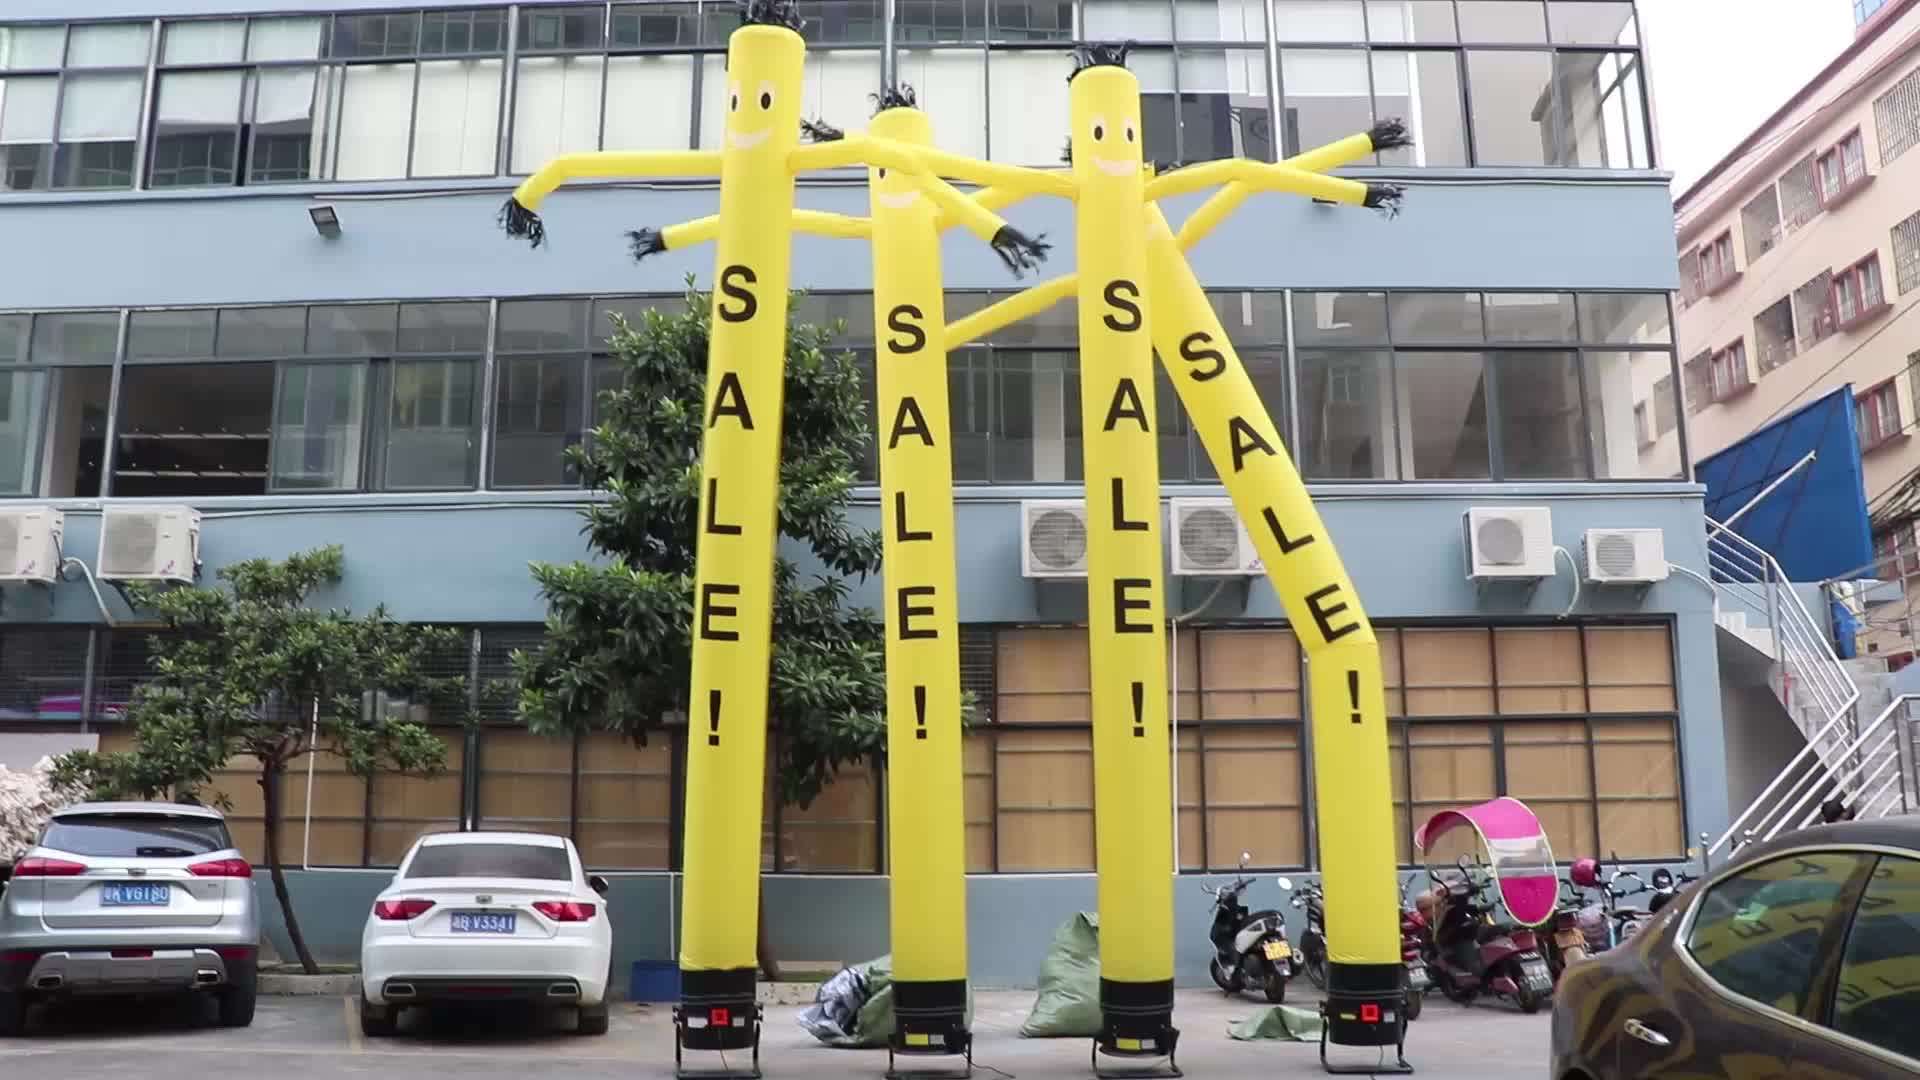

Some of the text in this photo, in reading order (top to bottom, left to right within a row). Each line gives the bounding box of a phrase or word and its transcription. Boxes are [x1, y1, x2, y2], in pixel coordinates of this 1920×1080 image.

[700, 265, 757, 748] SALE!
[887, 305, 938, 740] SALE!
[1103, 280, 1154, 738] SALE!
[1180, 332, 1371, 725] SALE!
